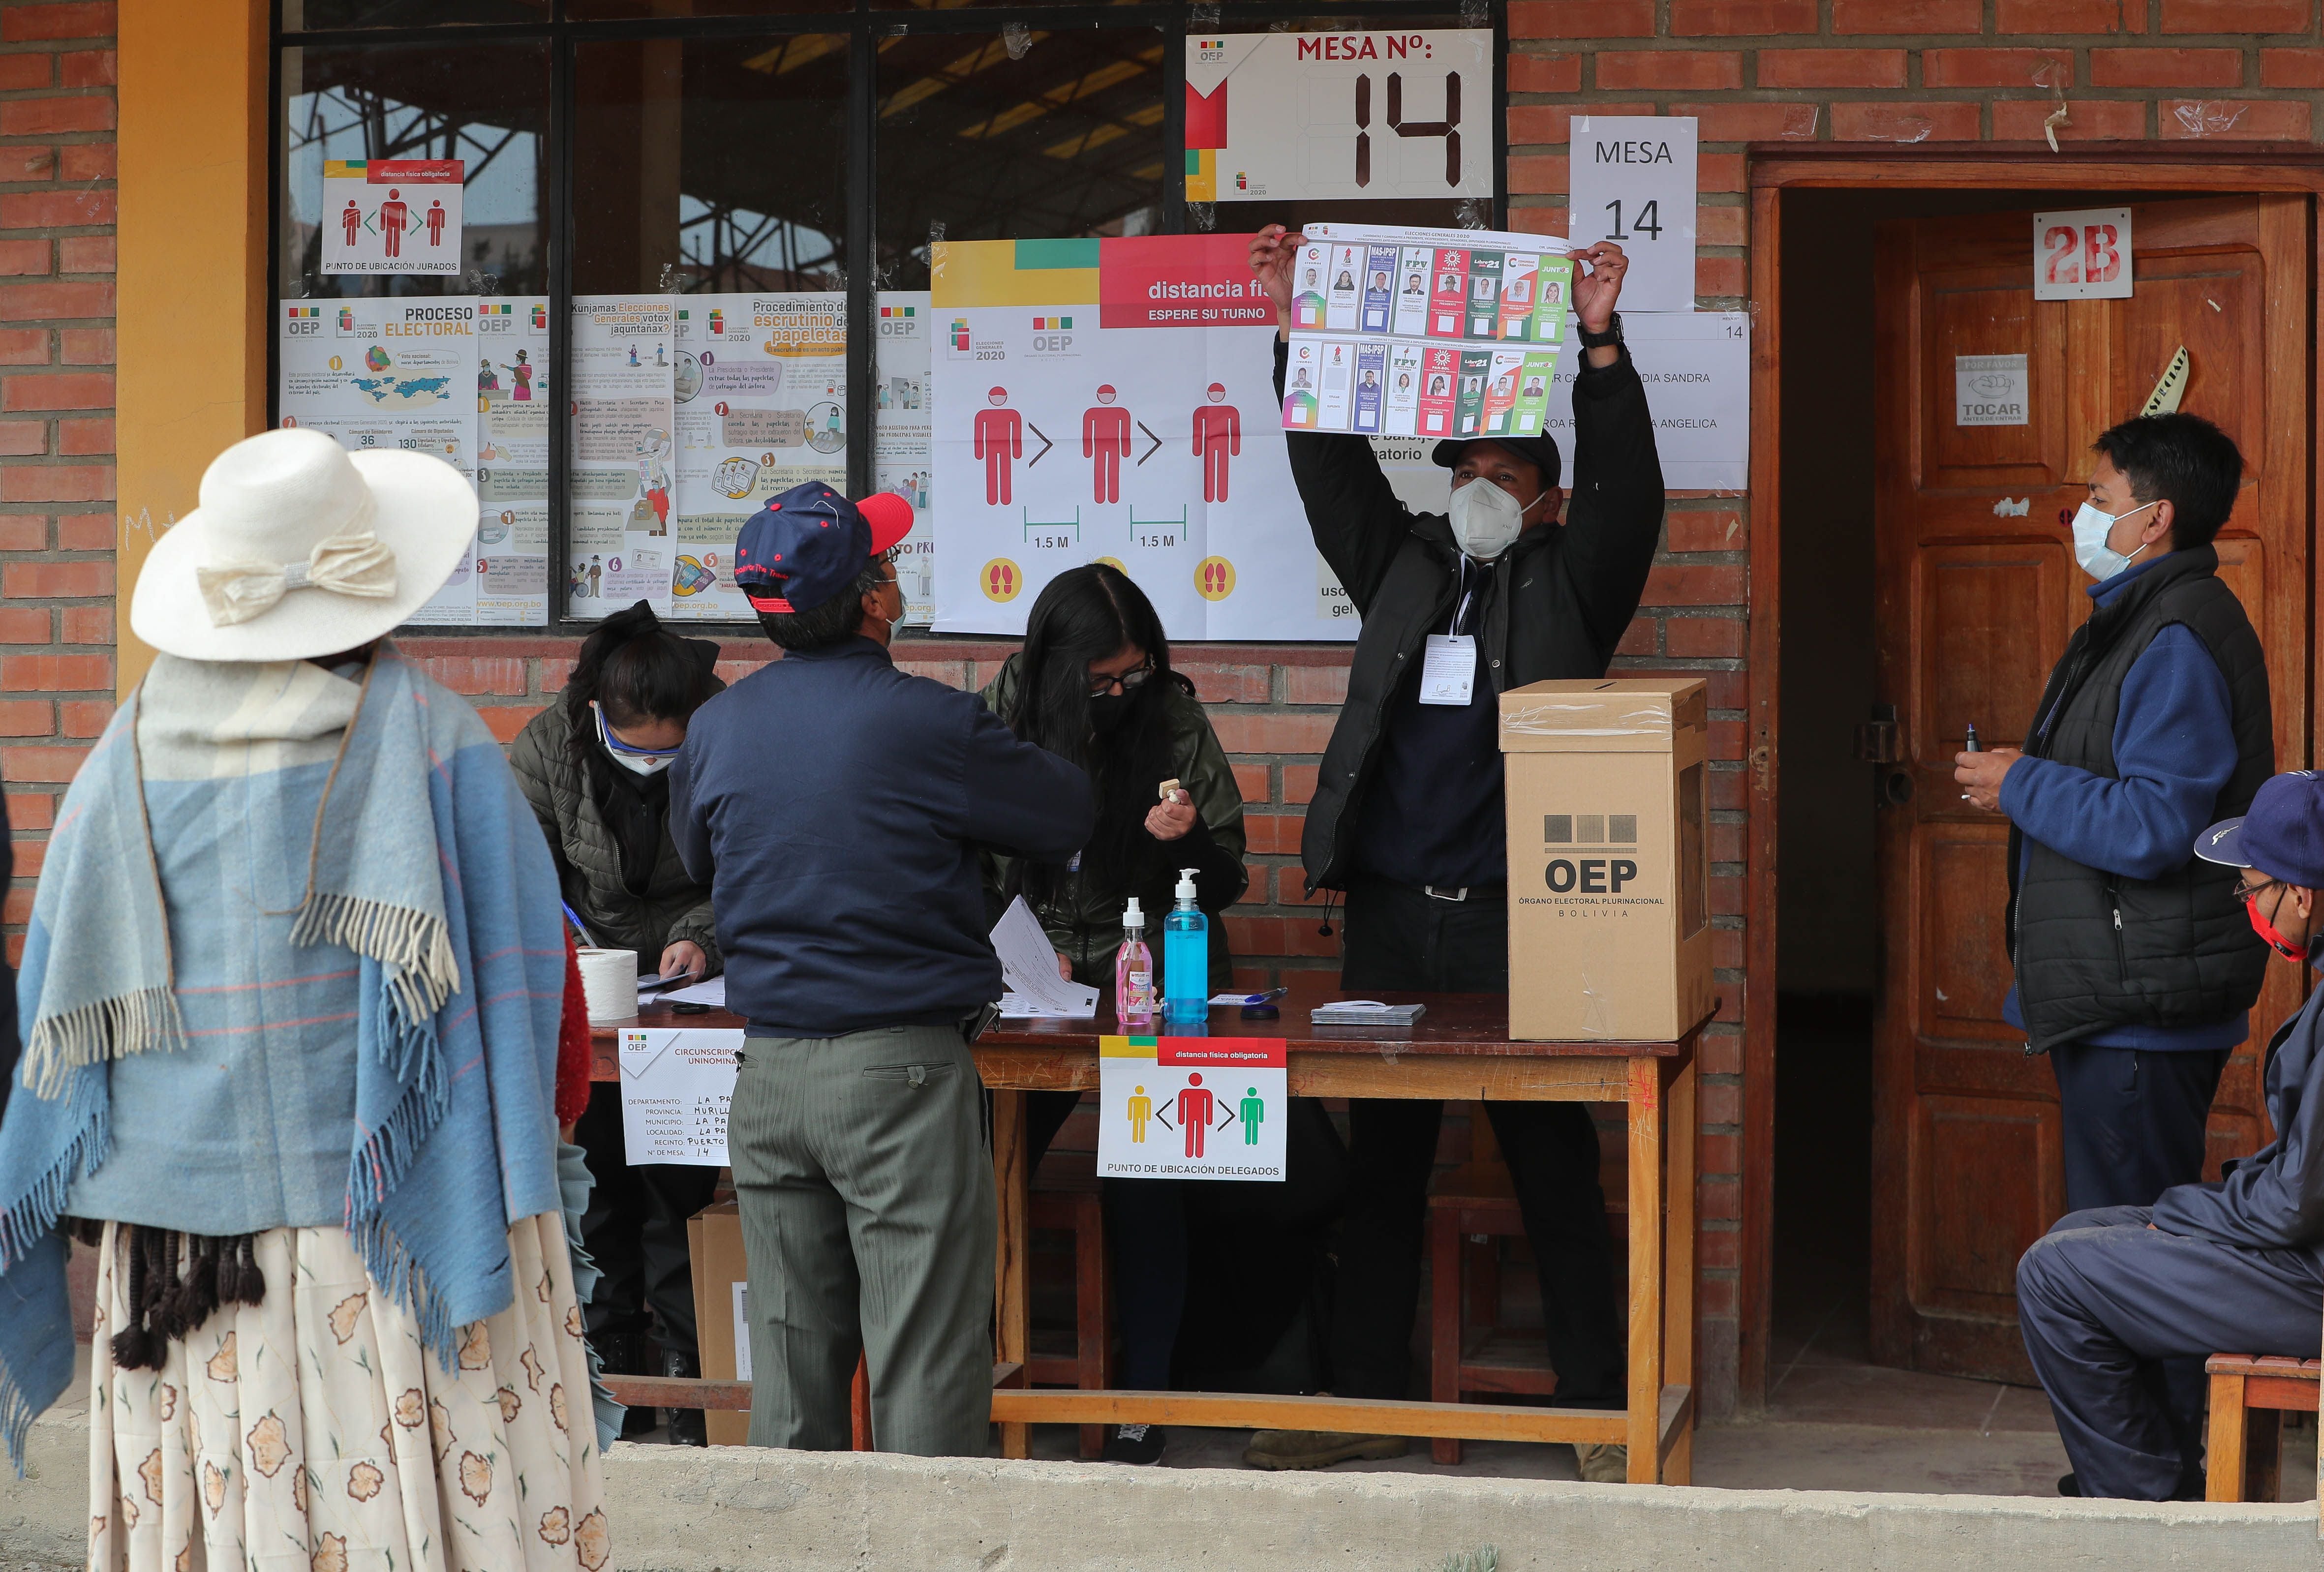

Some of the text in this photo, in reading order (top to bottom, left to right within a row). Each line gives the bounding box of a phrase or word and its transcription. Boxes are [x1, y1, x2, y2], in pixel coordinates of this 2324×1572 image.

[1297, 35, 1378, 60] MESA
[1200, 52, 1223, 60] OEP
[1356, 70, 1461, 188] 14
[1596, 141, 1673, 164] MESA
[1605, 199, 1663, 241] 14
[1371, 247, 1395, 256] MAS-IPSP
[2044, 224, 2120, 284] 2B
[326, 262, 353, 271] PUNTO
[369, 261, 414, 270] UBICACIÓN
[417, 262, 457, 271] JURADOS
[1148, 279, 1243, 299] distancia
[572, 303, 669, 315] Kunjamas Elecciones
[753, 302, 833, 312] Procedimiento
[406, 307, 473, 321] PROCESO
[594, 314, 641, 323] Generales
[754, 313, 832, 327] escrutinio
[1148, 307, 1265, 321] ESPERE SU TURNO
[289, 322, 320, 334] OEP
[385, 322, 473, 336] ELECTORAL
[479, 319, 512, 332] OEP
[611, 324, 670, 334] jaquntañax?
[881, 322, 915, 335] OEP
[772, 329, 847, 344] papeletas
[1726, 326, 1743, 338] 14
[1033, 336, 1072, 351] OEP
[1360, 344, 1384, 355] MAS-IPSP
[976, 351, 1005, 361] 2020
[1640, 374, 1711, 383] DIA SANDRA
[1963, 404, 2020, 415] TOCAR
[1660, 419, 1717, 428] ANGELICA
[361, 436, 374, 445] 36
[398, 439, 417, 449] 130
[1376, 448, 1422, 460] atorio
[1035, 536, 1068, 548] 1.5 M
[1140, 535, 1174, 547] 1.5 M
[1332, 603, 1353, 617] gel
[1545, 859, 1637, 894] OEP
[697, 1148, 709, 1157] 14
[1107, 1163, 1279, 1176] PUNTO DE UBICACIÓN DELEGADOS
